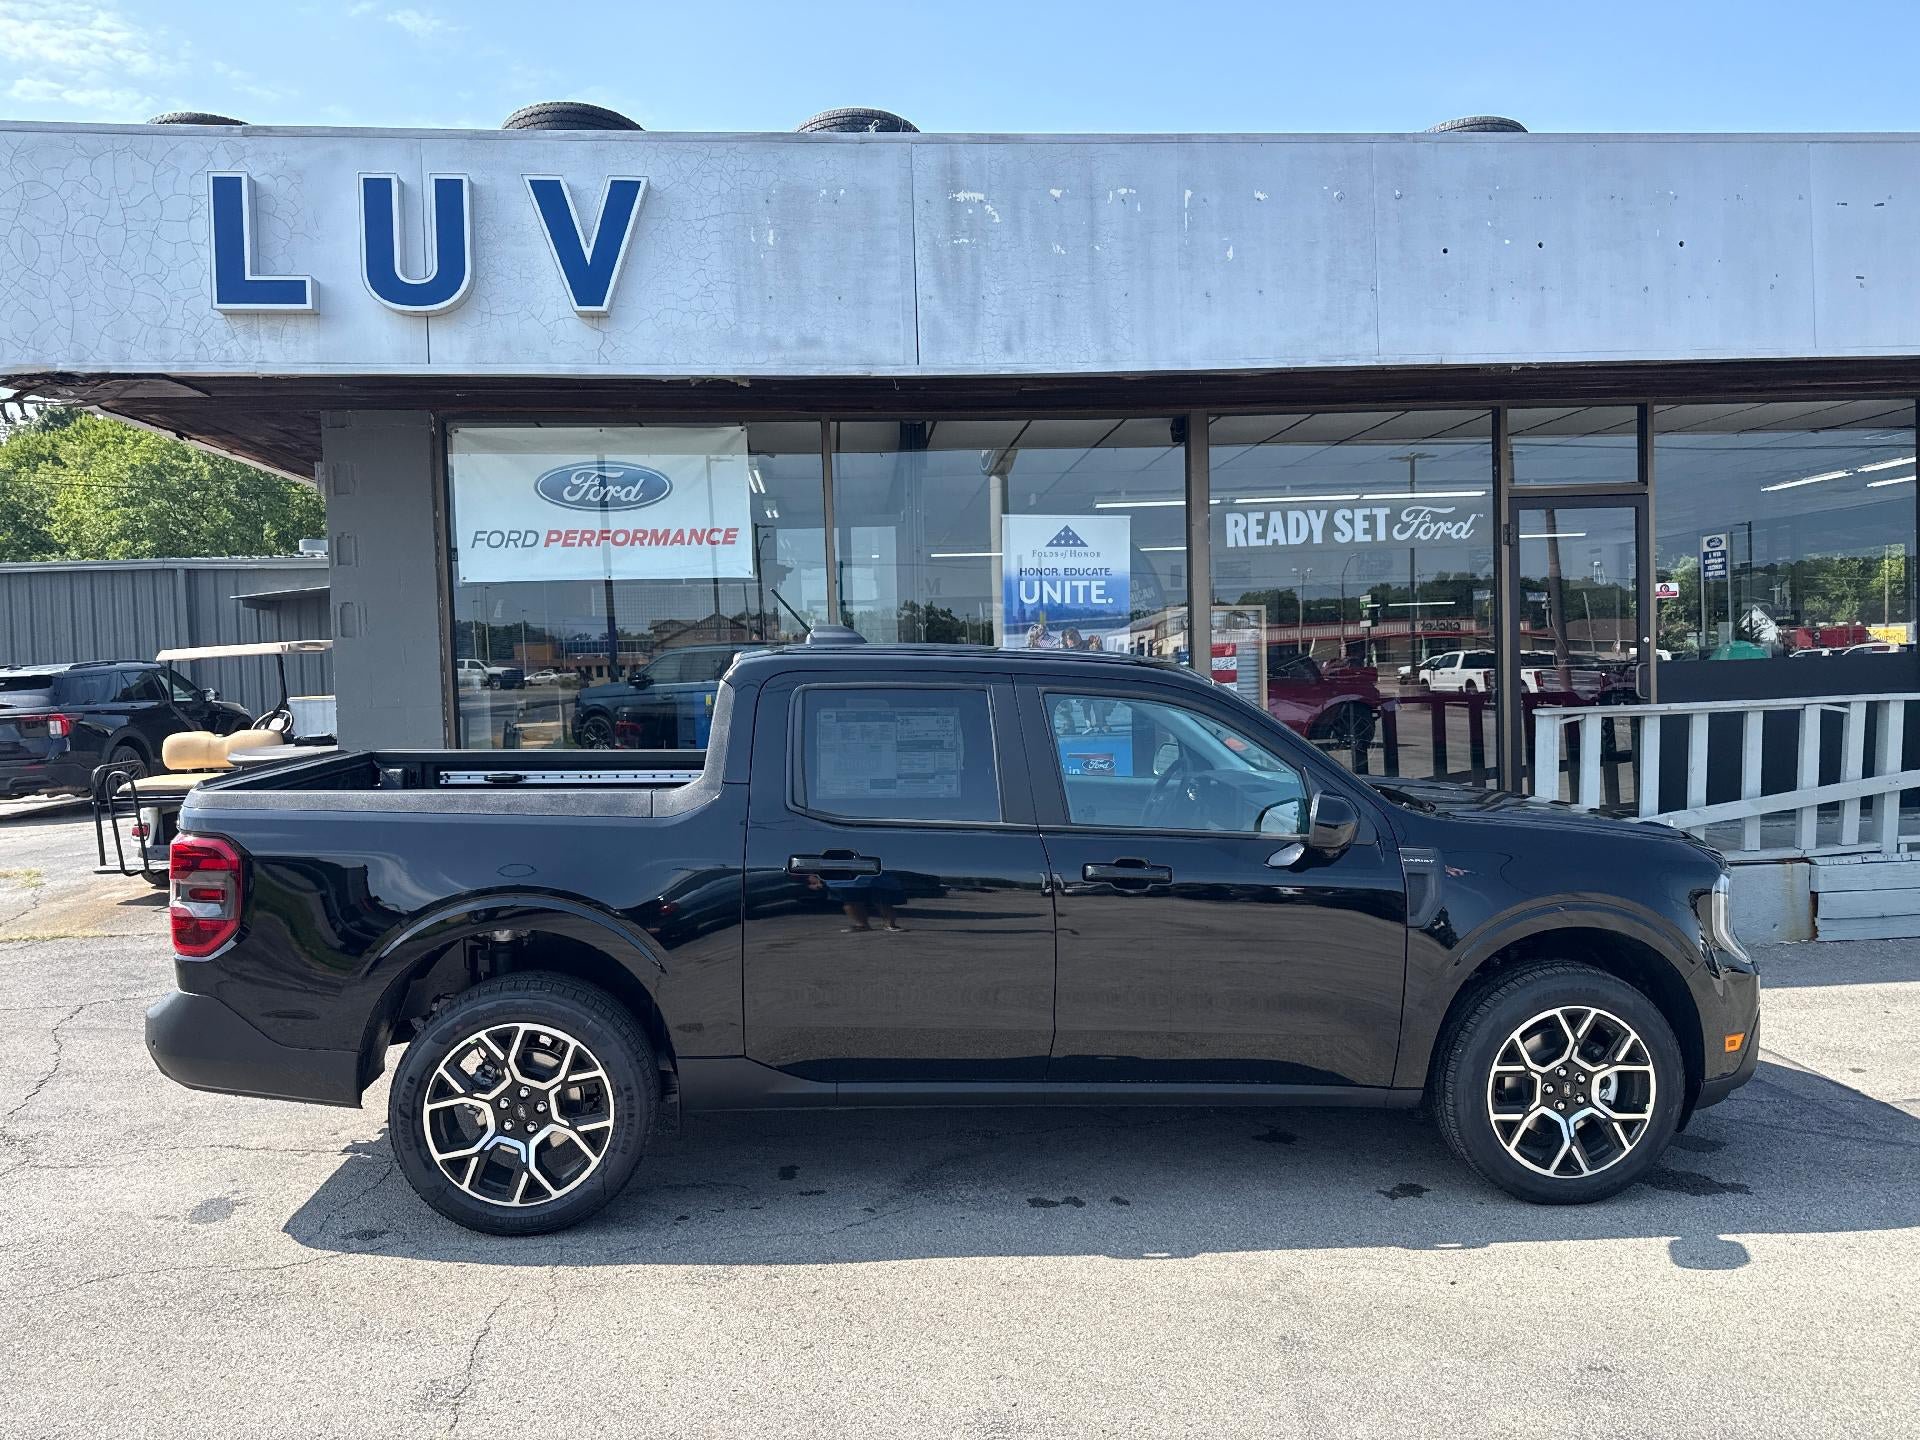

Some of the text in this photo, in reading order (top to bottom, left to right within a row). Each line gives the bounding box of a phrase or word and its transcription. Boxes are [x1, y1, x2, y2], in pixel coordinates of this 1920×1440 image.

[207, 171, 650, 316] LUV
[562, 468, 644, 503] Ford
[471, 527, 740, 549] FORD PERFORMANCE
[1225, 508, 1329, 548] READY
[1333, 507, 1391, 544] SET
[1020, 567, 1113, 577] HONOR. EDUCATE.
[1019, 580, 1114, 605] UNITE.
